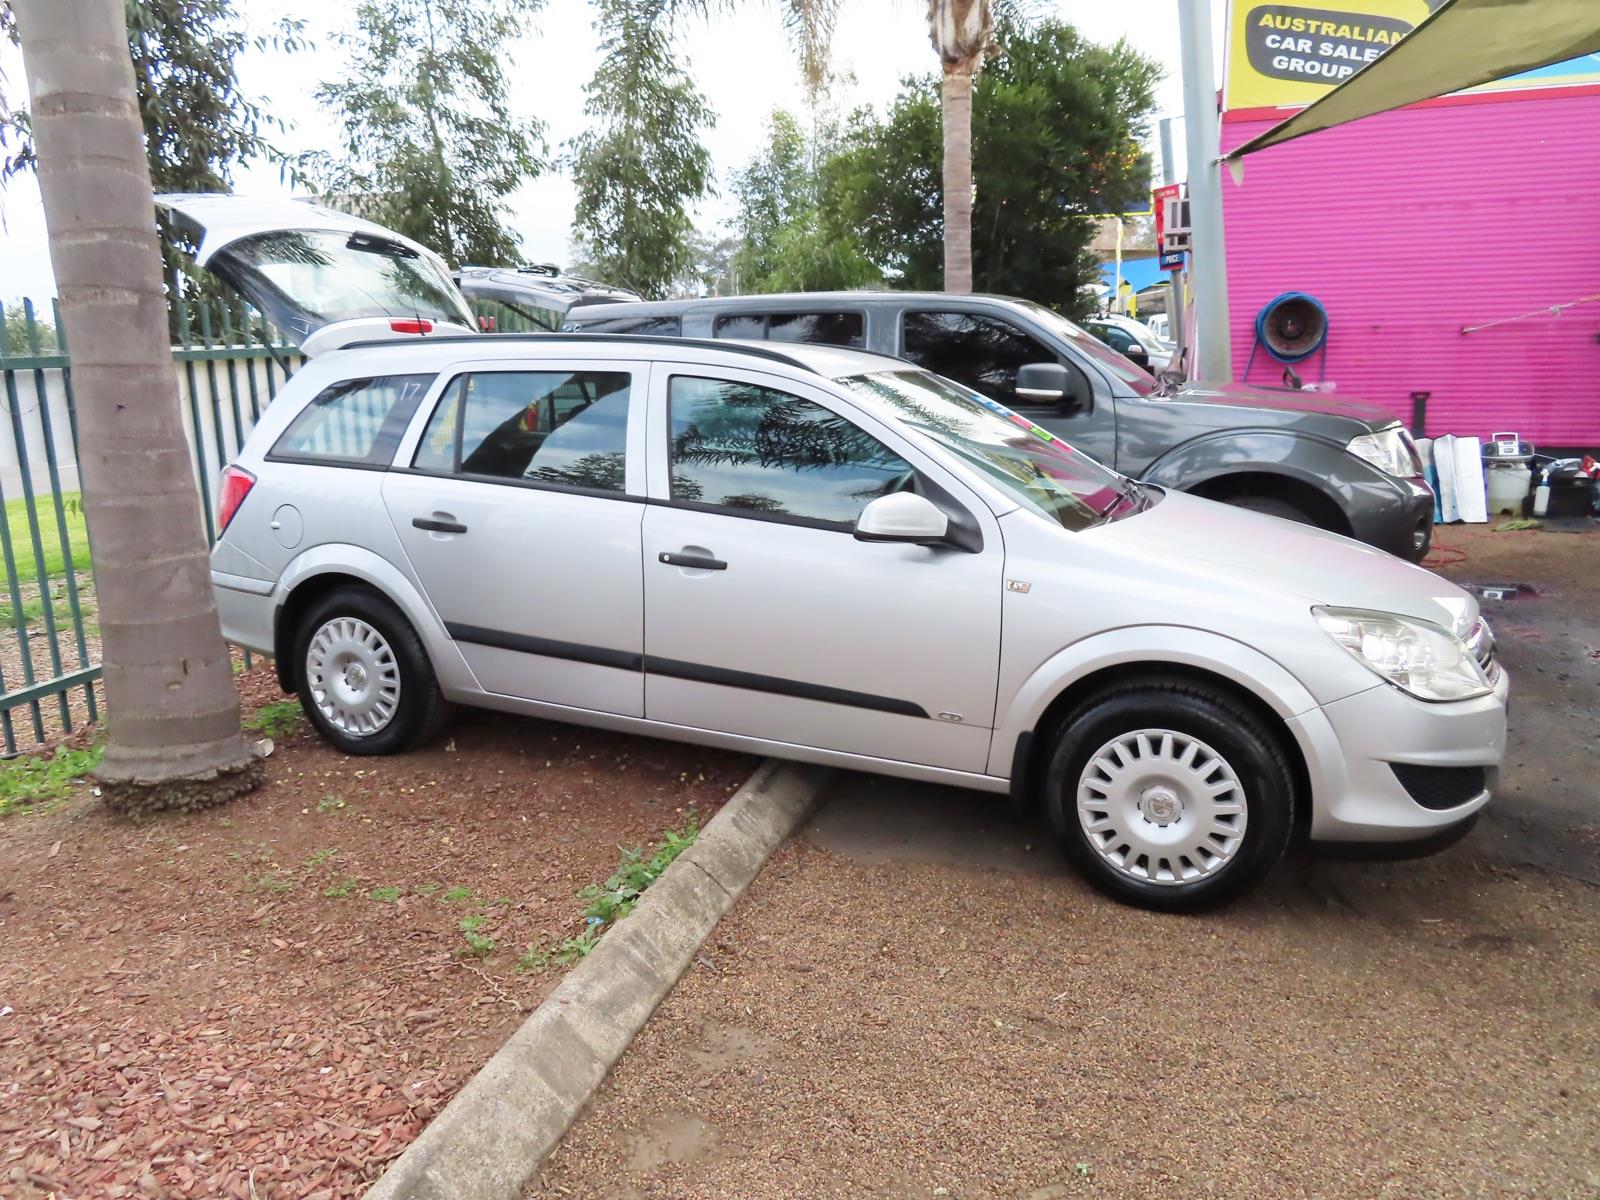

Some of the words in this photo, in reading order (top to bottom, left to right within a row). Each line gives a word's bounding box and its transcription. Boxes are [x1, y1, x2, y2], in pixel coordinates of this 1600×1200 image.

[1265, 35, 1313, 54] CAR
[1318, 42, 1387, 62] SALE
[1272, 55, 1353, 79] GROUP
[400, 382, 421, 401] 17
